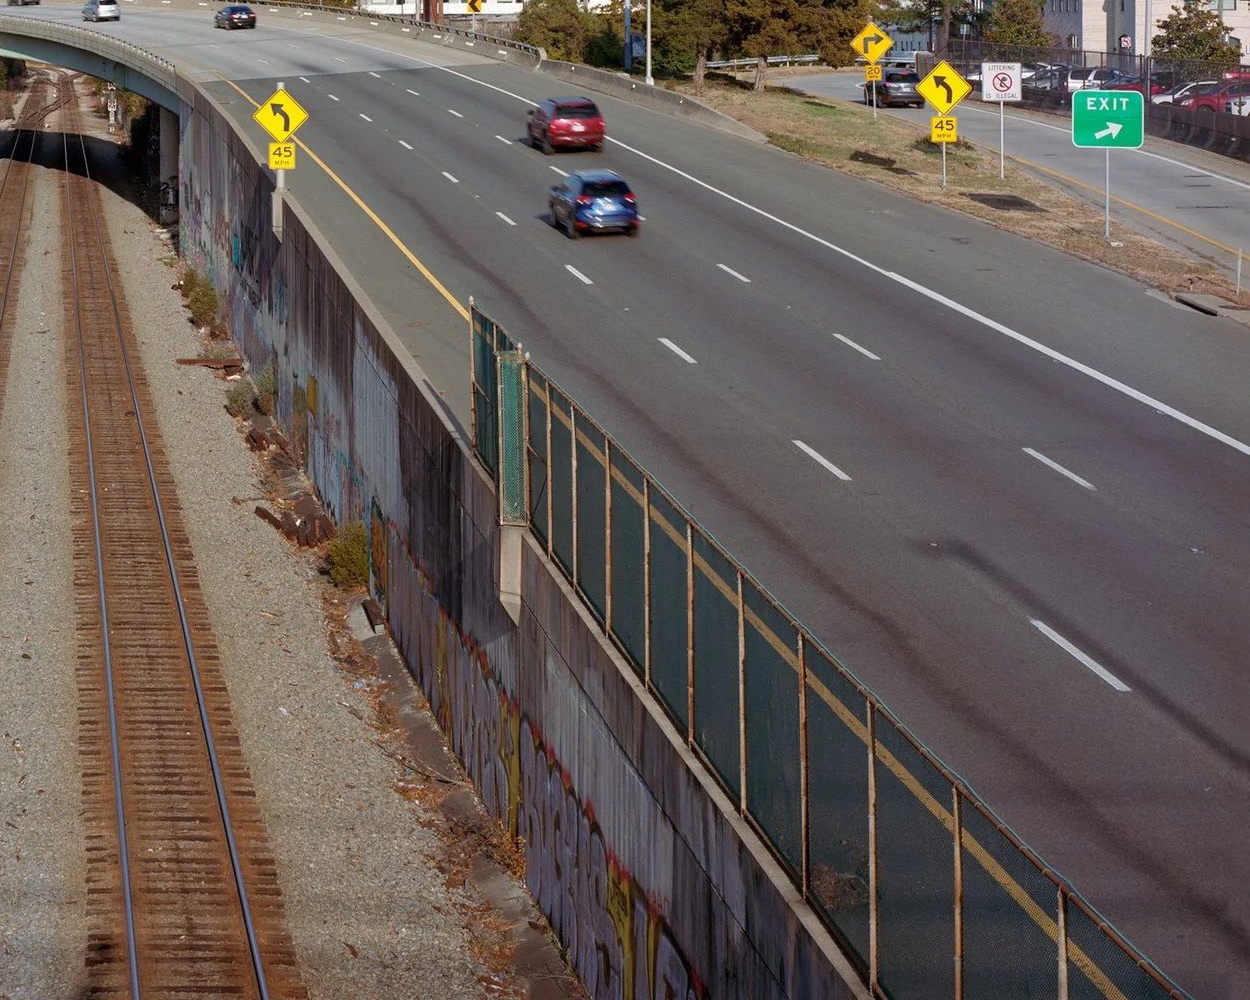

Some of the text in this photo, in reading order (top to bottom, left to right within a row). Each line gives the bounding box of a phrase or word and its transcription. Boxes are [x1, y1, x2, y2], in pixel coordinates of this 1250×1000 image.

[1086, 97, 1130, 111] EXIT
[934, 120, 955, 131] 45
[272, 146, 293, 158] 45
